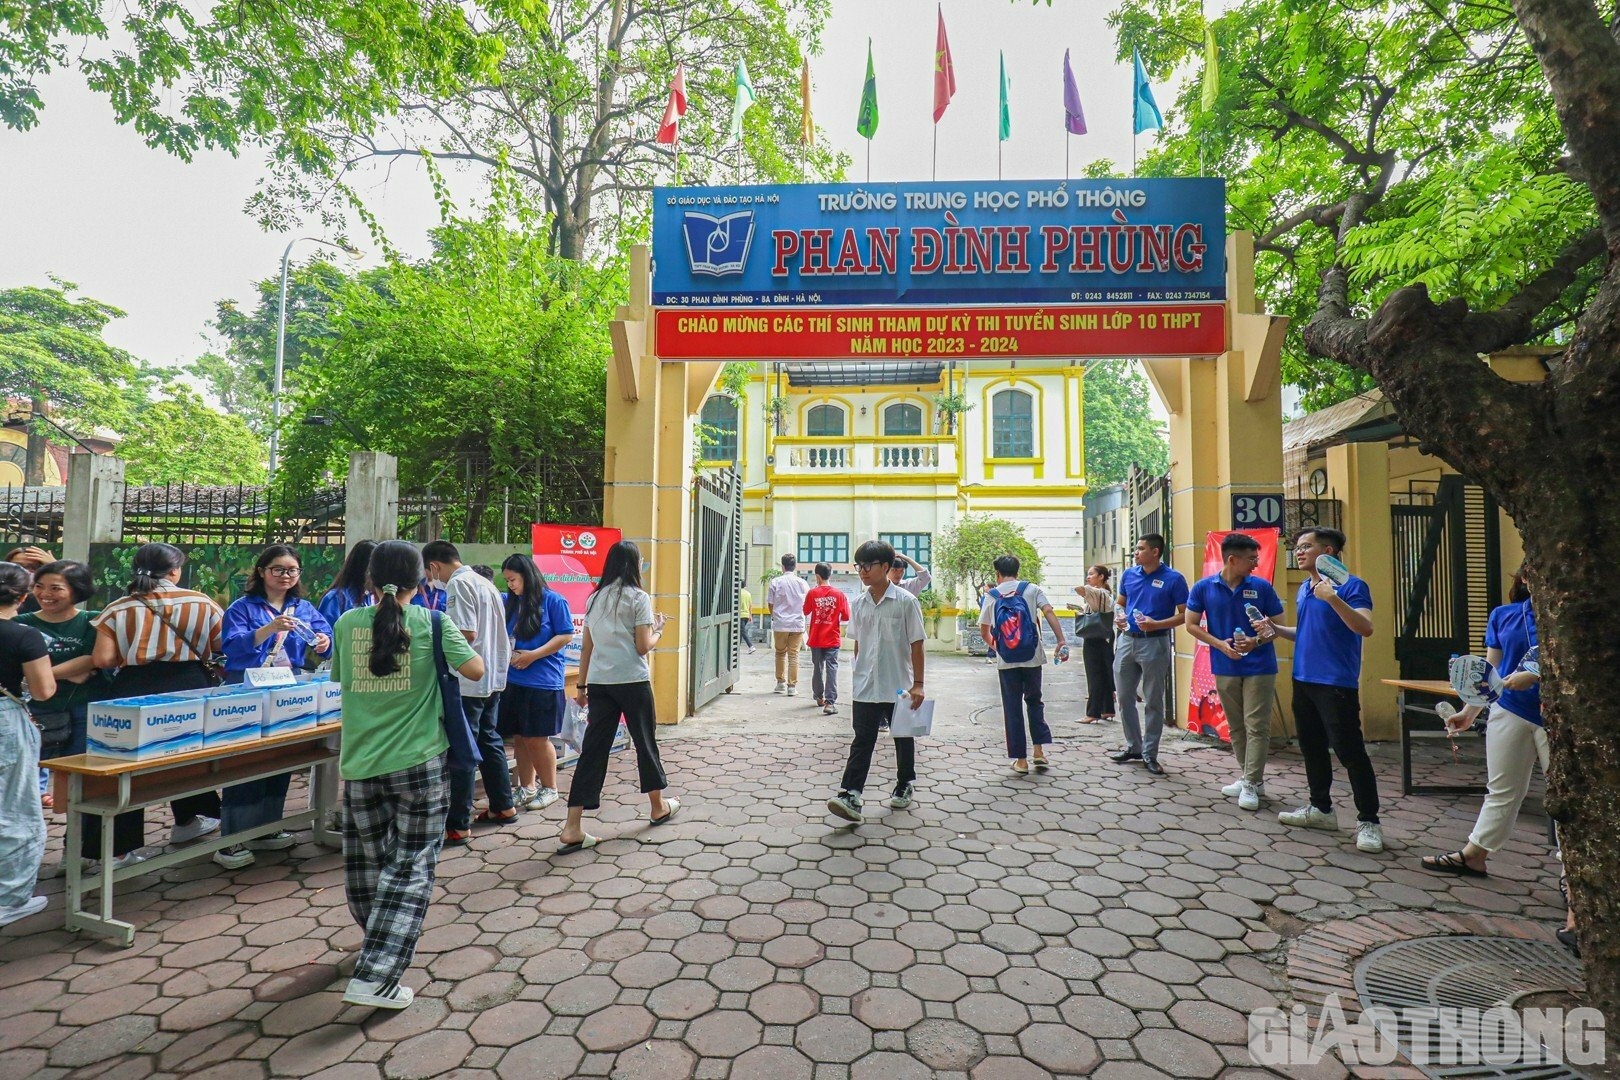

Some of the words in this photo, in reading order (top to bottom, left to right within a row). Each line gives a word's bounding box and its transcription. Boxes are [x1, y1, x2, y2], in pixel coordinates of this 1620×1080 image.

[697, 196, 711, 206] DỤC
[713, 194, 721, 204] VÀ
[740, 195, 753, 205] TẠO
[755, 193, 765, 203] HÀ
[767, 193, 780, 204] NỘI
[818, 188, 897, 211] TRƯỜNG
[904, 191, 967, 211] TRUNG
[974, 190, 1020, 213] HỌC
[1027, 181, 1069, 209] PHỔ
[1076, 186, 1146, 207] THÔNG
[770, 226, 901, 278] PHAN
[910, 210, 1031, 276] ĐÌNH
[1039, 208, 1207, 275] PHÙNG
[681, 296, 689, 304] 30
[691, 296, 710, 304] PHAN
[712, 294, 728, 304] ĐÌNH
[730, 294, 753, 304] PHÙNG
[761, 295, 771, 303] BA
[774, 293, 789, 303] ĐÌNH
[795, 293, 806, 303] HÀ
[1071, 292, 1083, 300] ĐT:
[1084, 292, 1102, 300] 0243
[1106, 292, 1133, 300] 8452811
[1147, 292, 1163, 300] FAX:
[1165, 292, 1182, 300] 0243
[677, 316, 718, 333] CHÀO
[723, 314, 769, 333] MỪNG
[773, 314, 804, 333] CÁC
[808, 314, 832, 333] THÍ
[836, 317, 873, 333] SINH
[877, 316, 921, 332] THAM
[925, 314, 948, 336] DỰ
[951, 312, 971, 332] KỲ
[976, 315, 1000, 331] THI
[1004, 308, 1055, 331] TUYỂN
[1059, 313, 1098, 330] SINH
[1102, 312, 1133, 330] LỚP
[1138, 313, 1157, 329] 10
[1161, 312, 1201, 329] THPT
[850, 335, 887, 354] NĂM
[891, 337, 923, 356] HỌC
[927, 338, 965, 353] 2023
[980, 336, 1019, 353] 2024
[1235, 497, 1280, 523] 30
[276, 695, 313, 707] UniAqua
[212, 704, 257, 717] UniAqua
[92, 714, 132, 732] UniAqua
[146, 712, 197, 727] UniAqua
